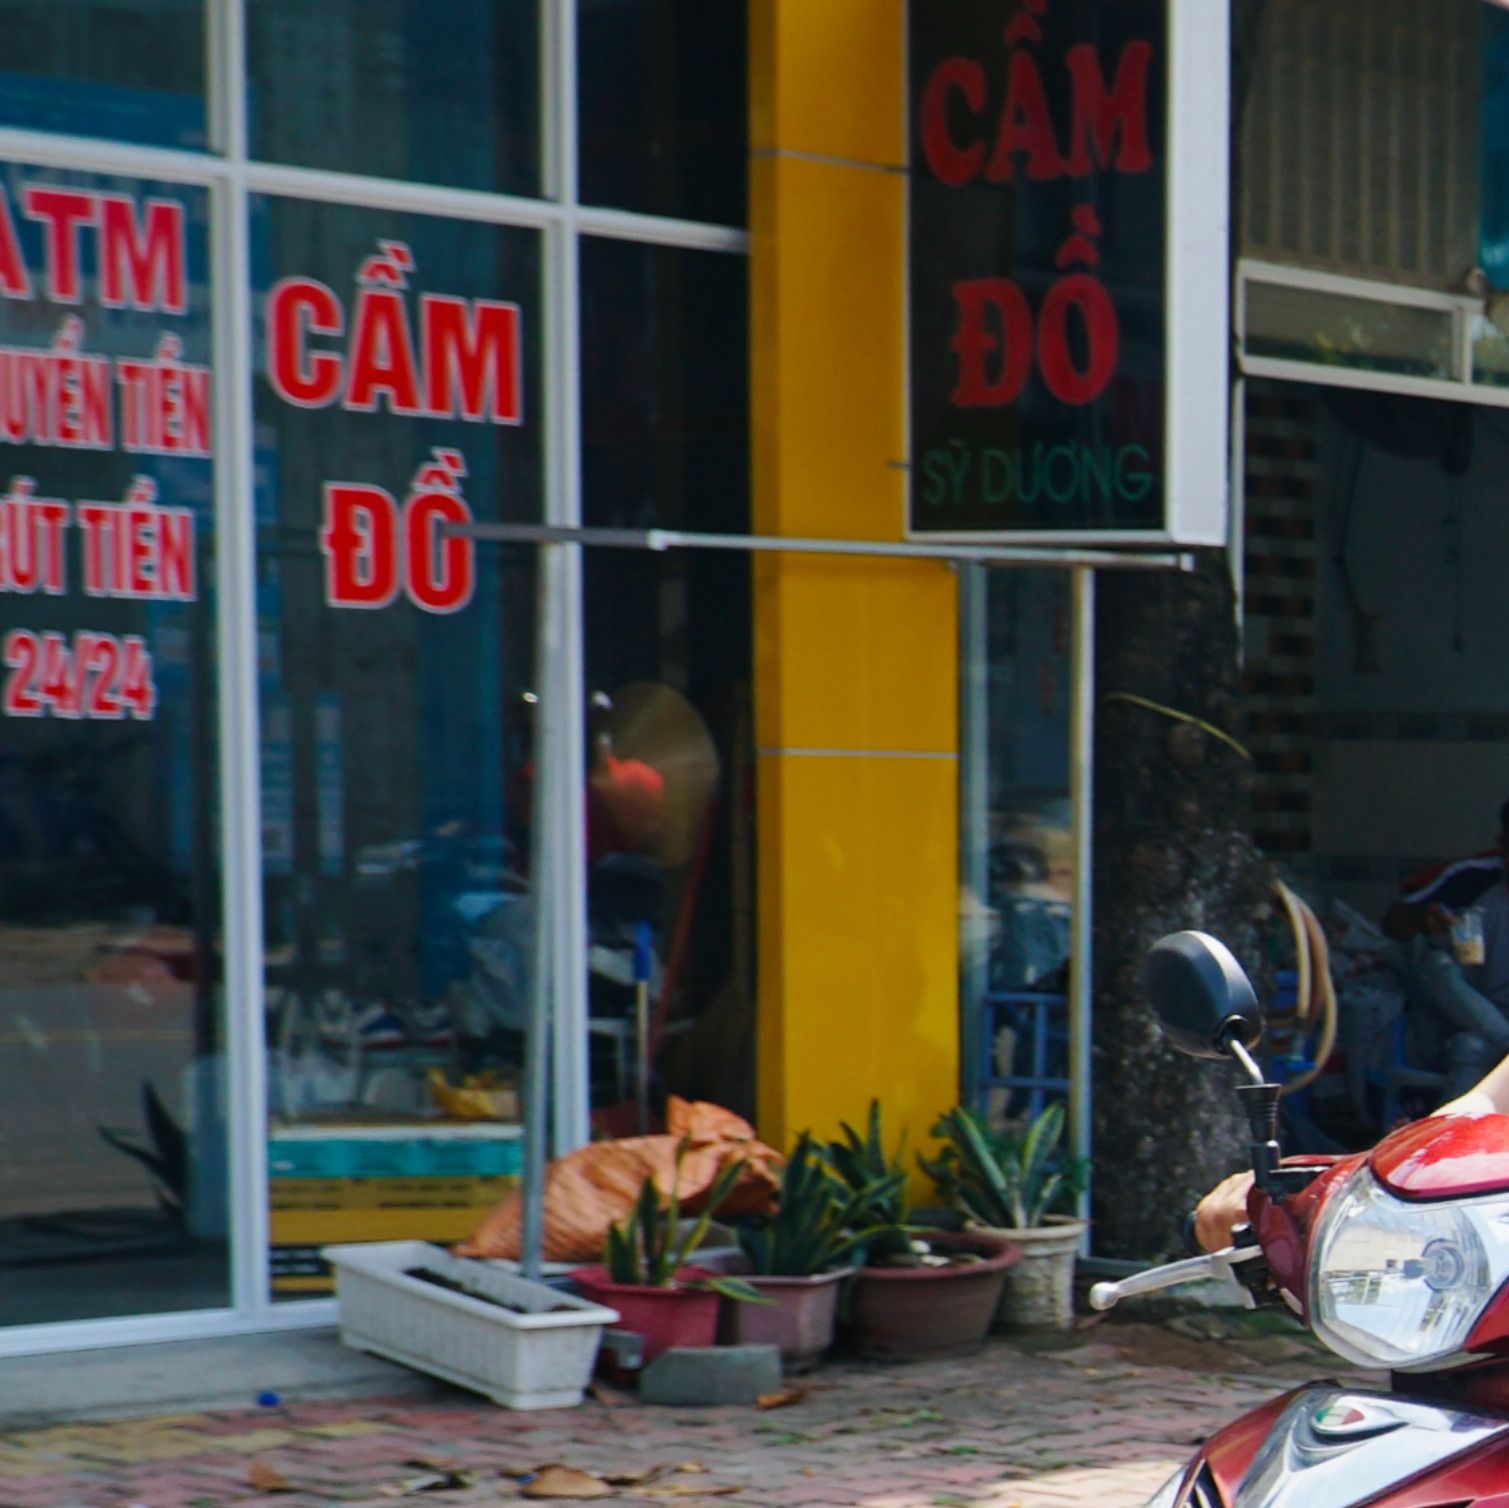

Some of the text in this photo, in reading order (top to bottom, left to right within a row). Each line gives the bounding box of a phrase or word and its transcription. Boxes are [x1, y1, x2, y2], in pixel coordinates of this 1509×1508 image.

[266, 240, 522, 424] CẦM
[950, 204, 1119, 408] ĐỒ
[76, 474, 196, 601] TIỀN
[322, 446, 474, 613] ĐỒ
[982, 440, 1152, 503] DƯƠNG
[4, 628, 154, 719] 24/24
